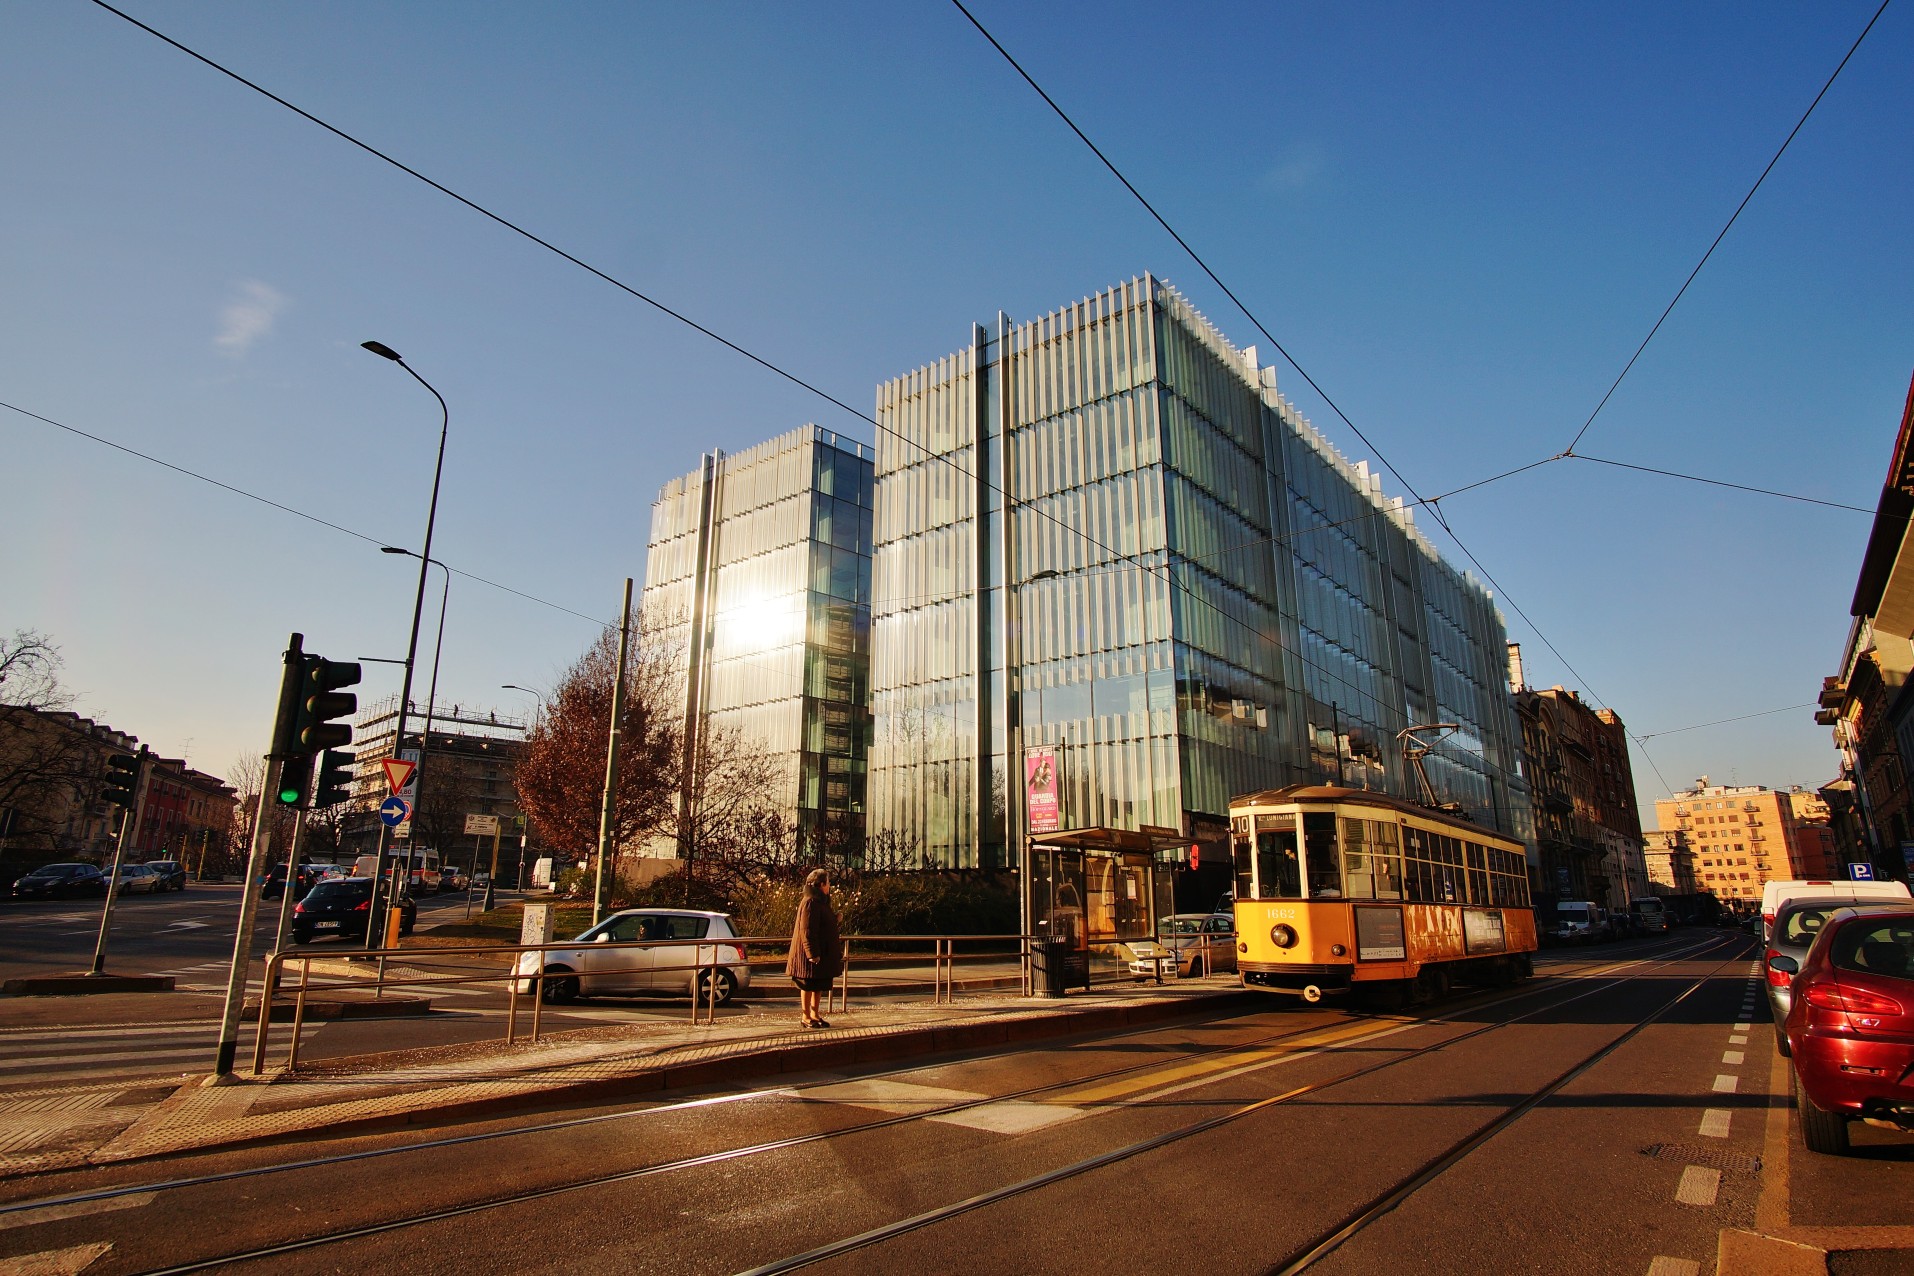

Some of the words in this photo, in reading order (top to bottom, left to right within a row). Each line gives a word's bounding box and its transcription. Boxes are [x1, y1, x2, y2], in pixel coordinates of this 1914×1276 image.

[1237, 816, 1249, 833] 10
[1853, 864, 1867, 878] P
[1267, 908, 1295, 919] 1662
